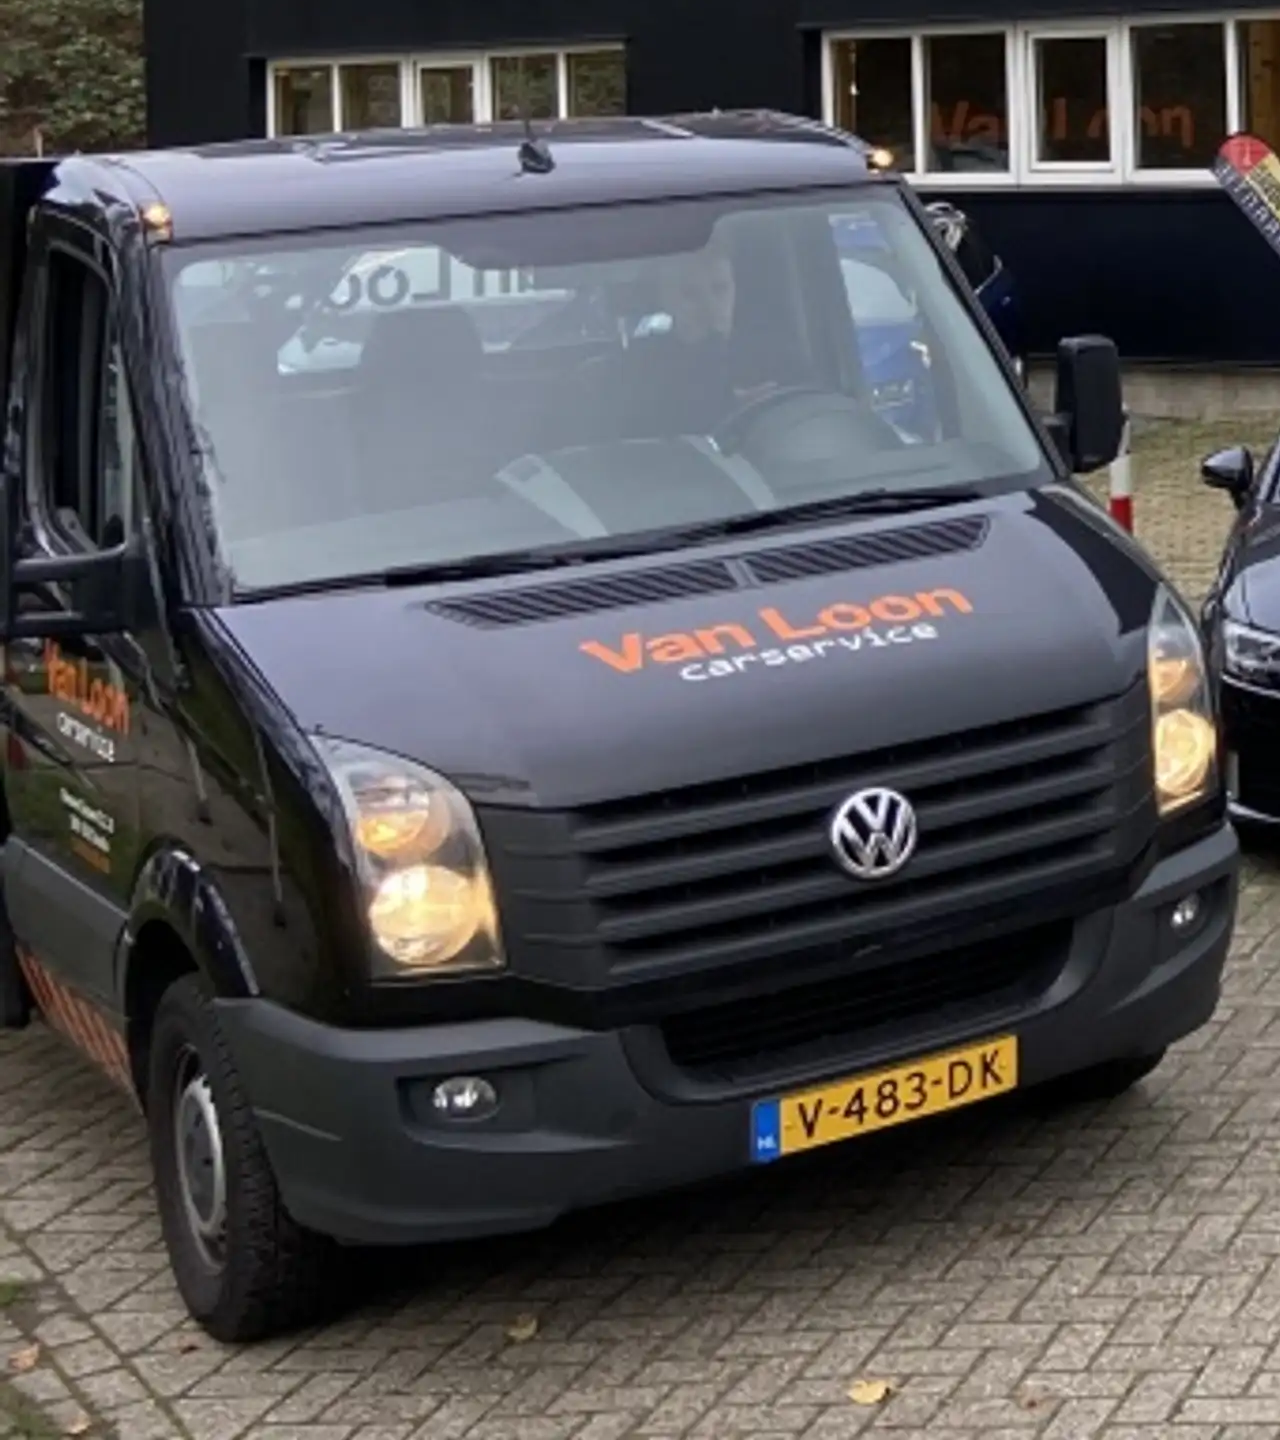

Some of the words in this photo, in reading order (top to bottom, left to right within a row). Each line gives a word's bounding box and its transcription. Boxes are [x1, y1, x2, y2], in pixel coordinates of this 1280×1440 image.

[579, 623, 757, 675] Van
[759, 586, 974, 641] Loon
[679, 620, 940, 682] carservice
[797, 1048, 1004, 1139] V-483-DK
